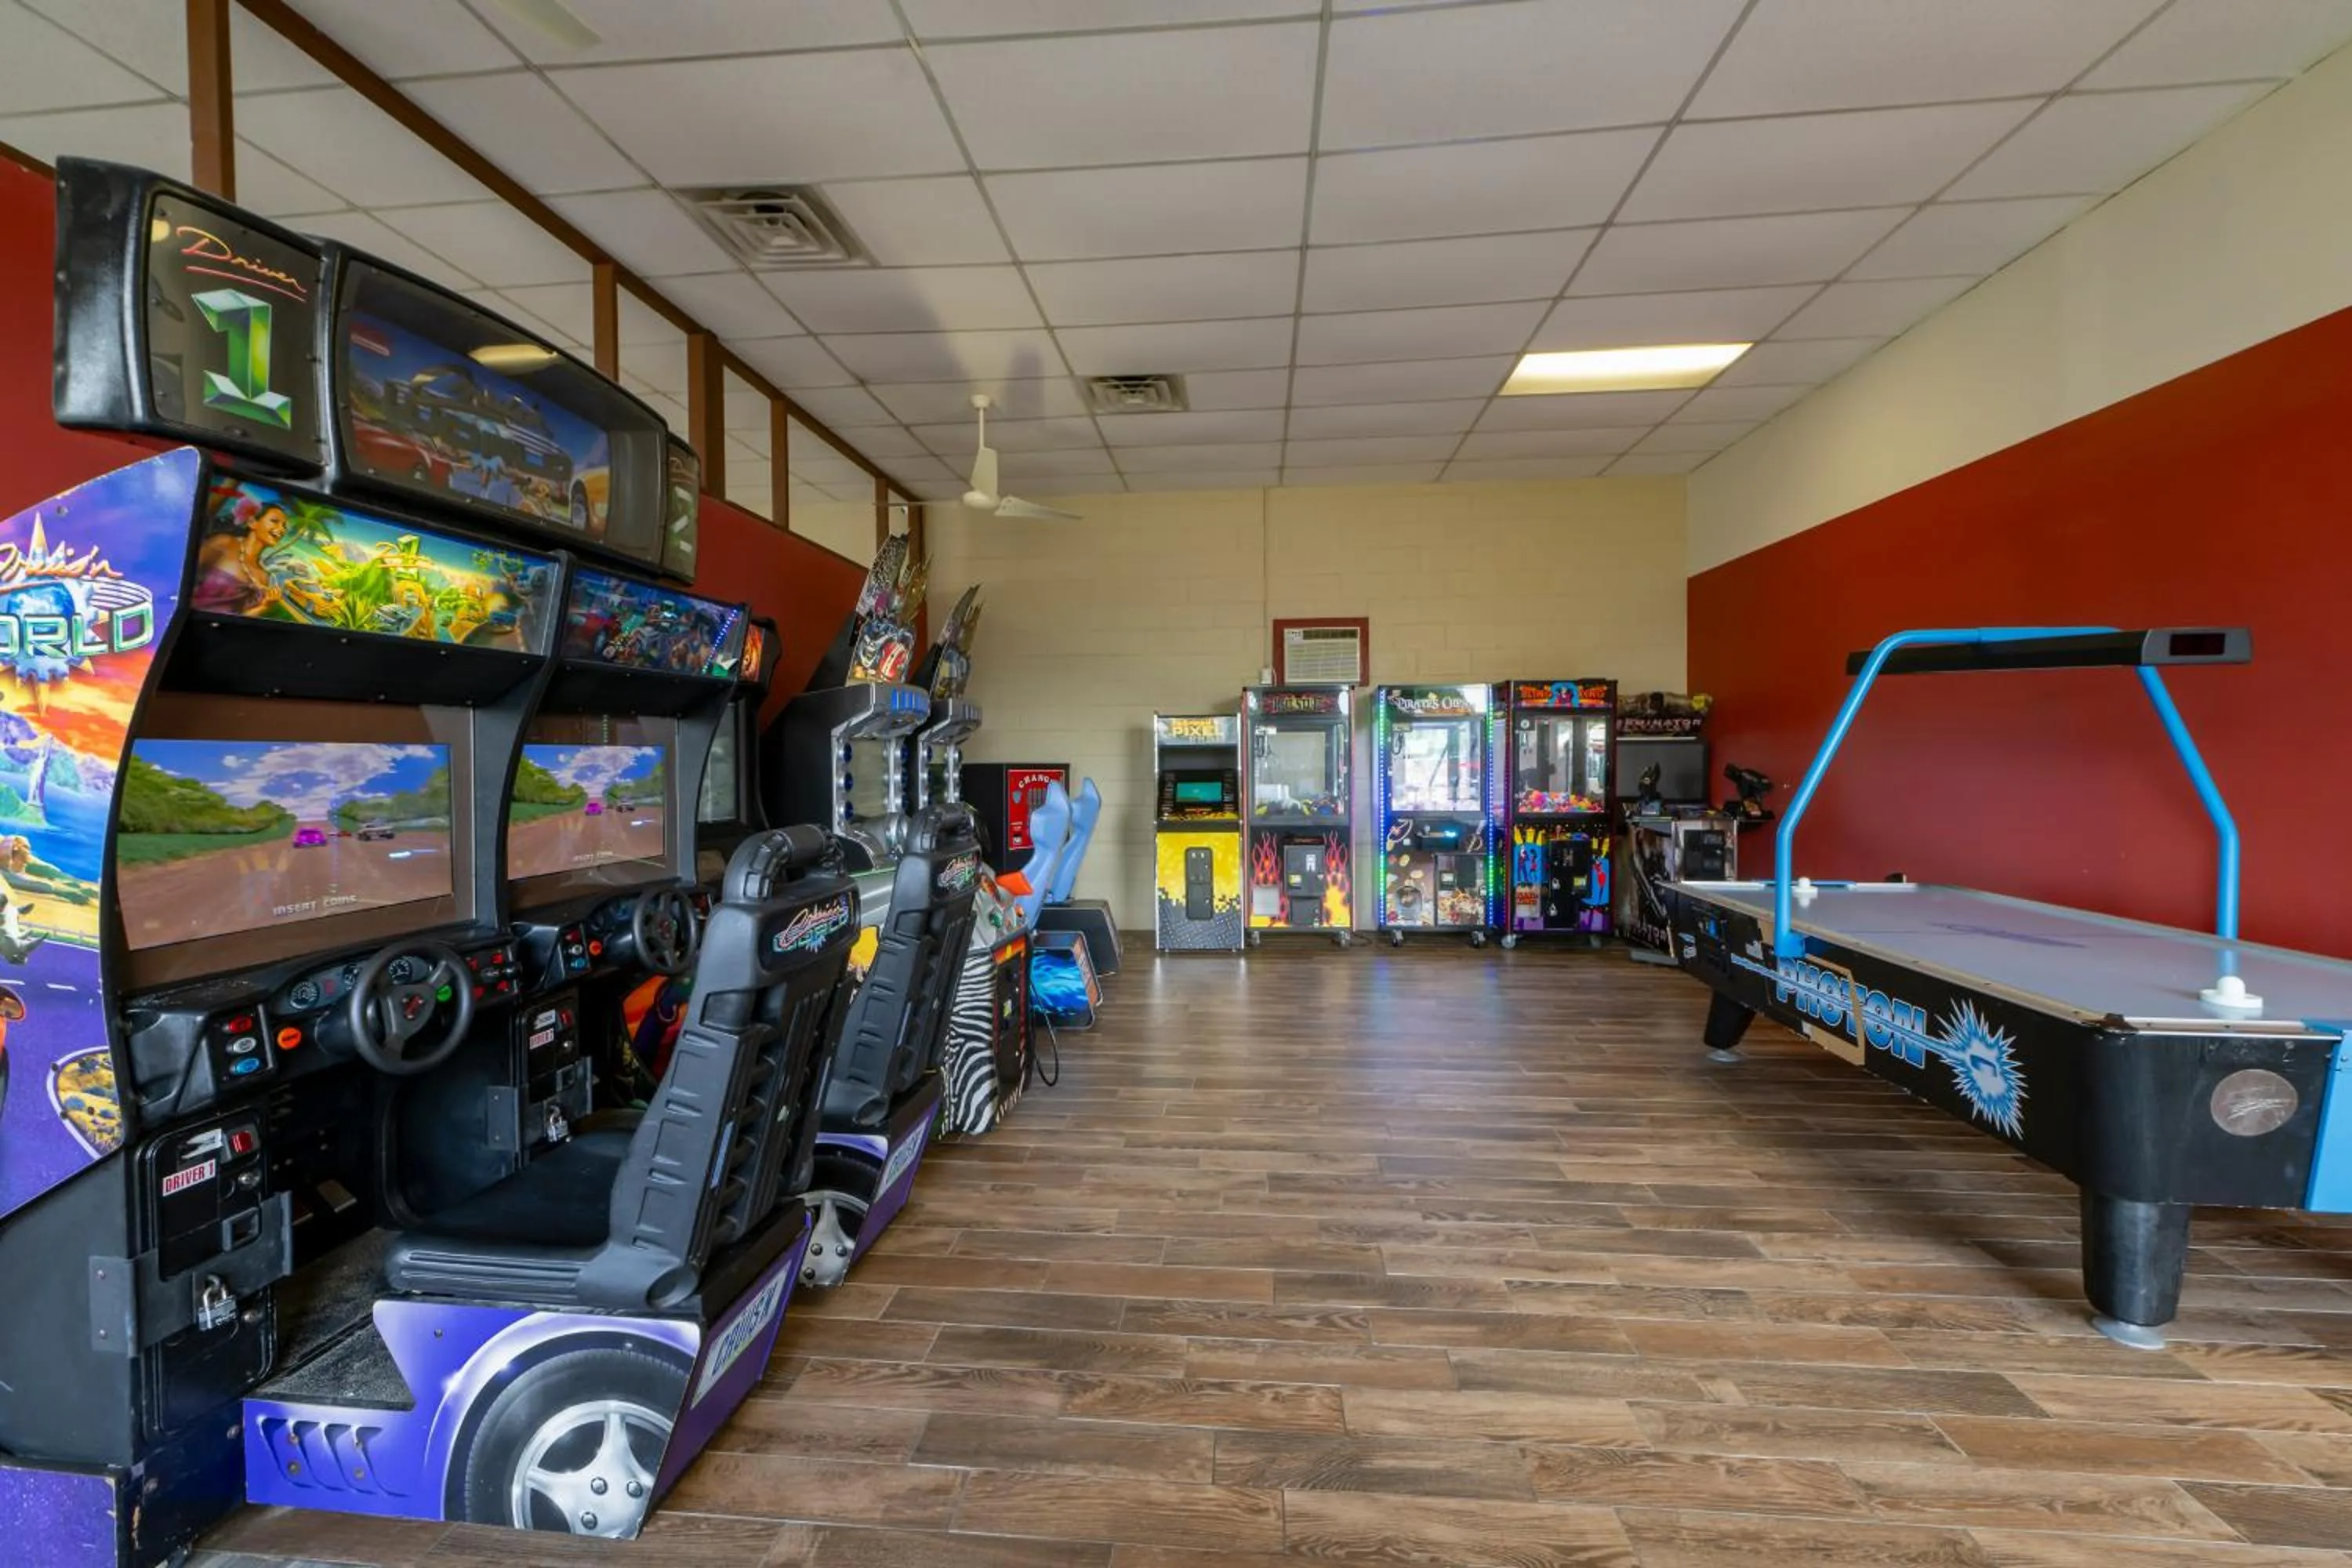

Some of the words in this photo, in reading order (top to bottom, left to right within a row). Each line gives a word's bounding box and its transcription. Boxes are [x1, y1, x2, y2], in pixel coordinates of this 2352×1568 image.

[191, 289, 292, 430] 1
[0, 600, 154, 659] RLD
[1616, 718, 1701, 731] ERMINATOR
[1018, 774, 1053, 788] CHANG
[1776, 956, 1927, 1069] PHOTON
[165, 1166, 204, 1192] DRIVER
[208, 1161, 214, 1176] 1
